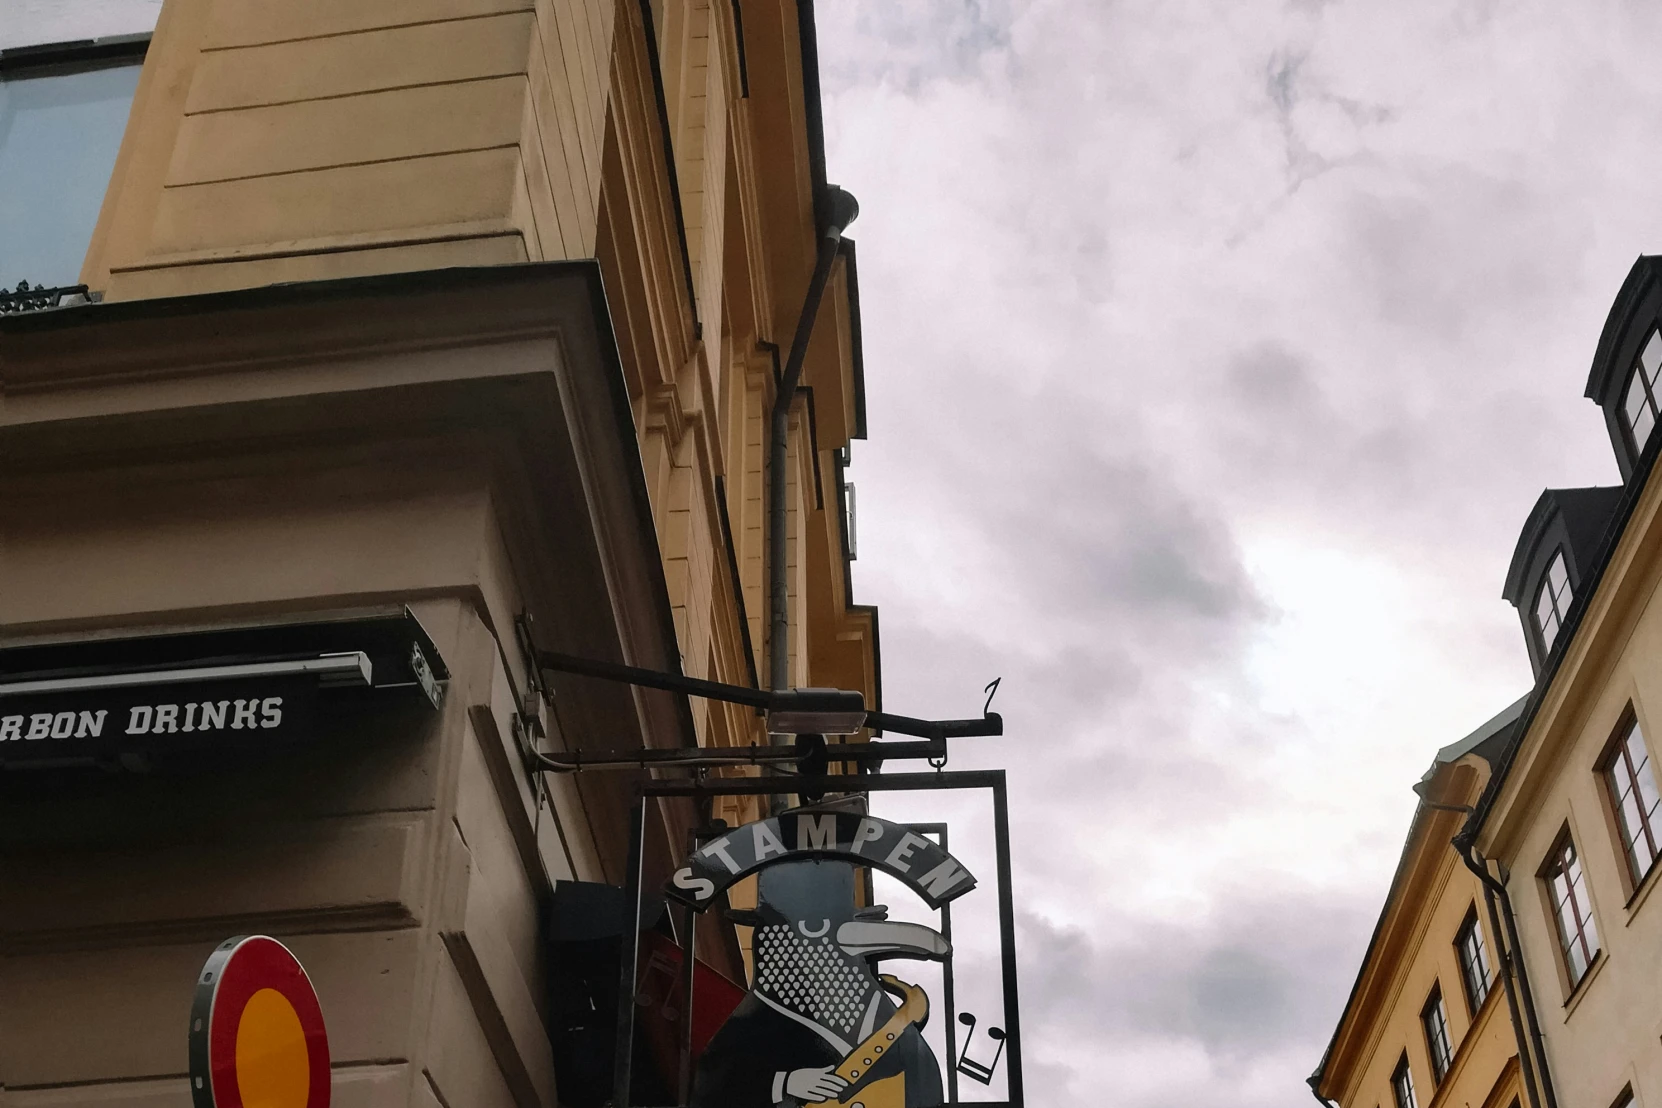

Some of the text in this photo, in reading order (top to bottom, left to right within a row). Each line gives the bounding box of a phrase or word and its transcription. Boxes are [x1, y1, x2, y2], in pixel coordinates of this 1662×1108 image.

[0, 696, 284, 741] RBON DRINKS
[672, 813, 969, 901] STAMPEN
